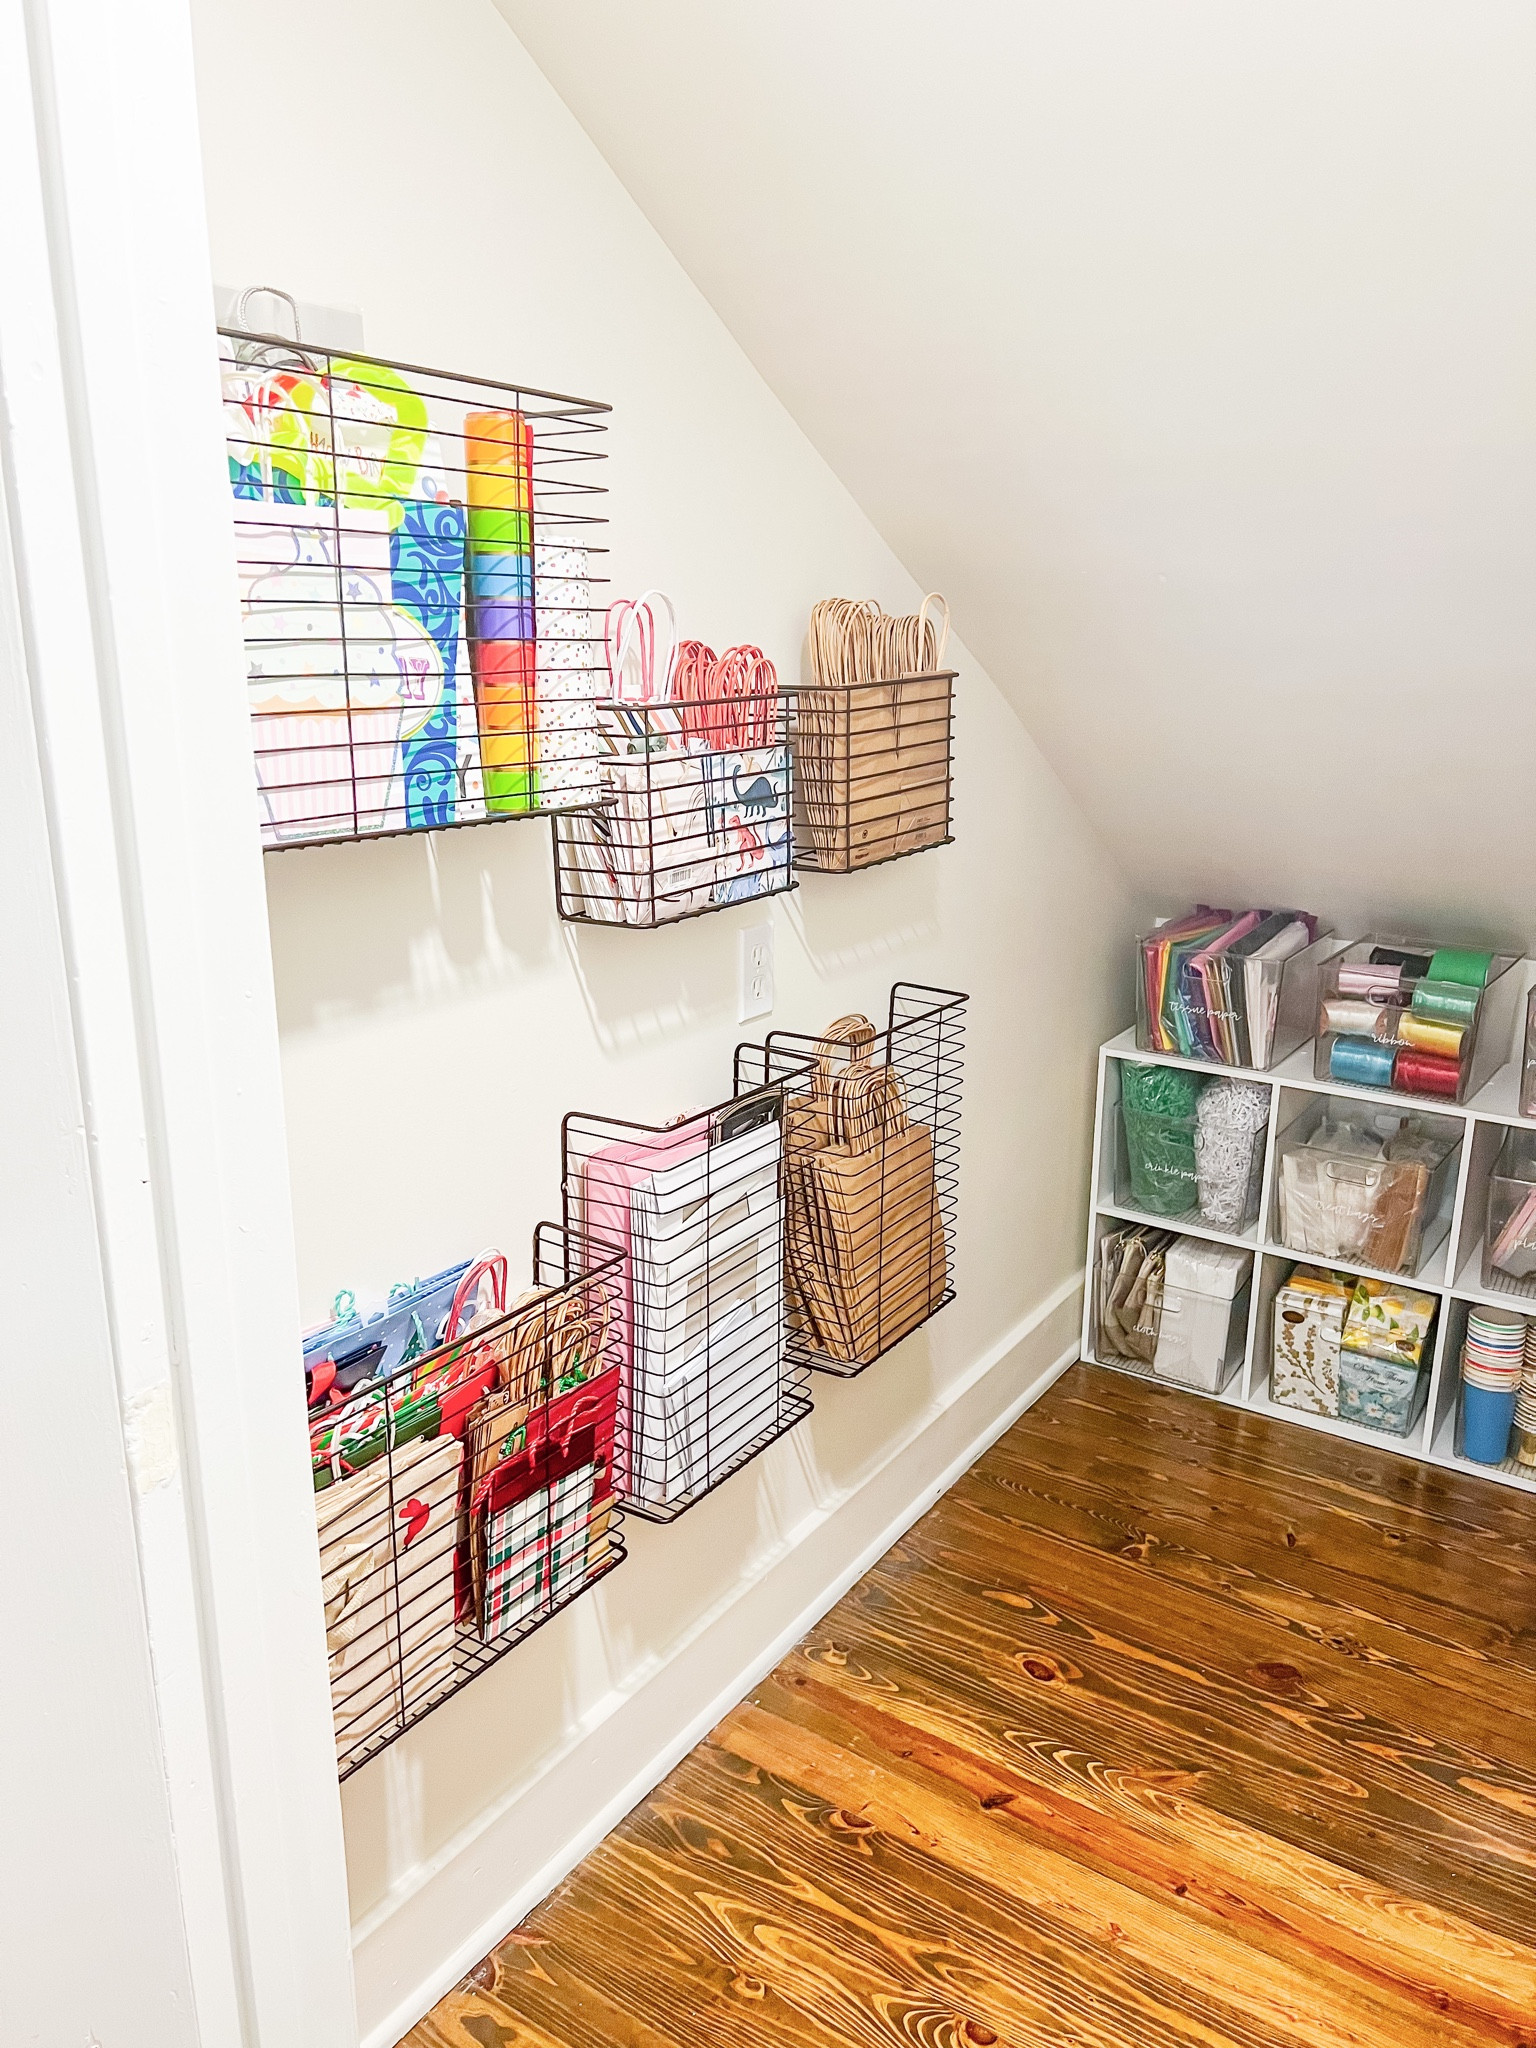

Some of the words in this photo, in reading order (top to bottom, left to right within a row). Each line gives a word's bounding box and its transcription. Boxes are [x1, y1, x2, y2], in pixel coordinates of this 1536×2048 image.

[1168, 1001, 1206, 1015] tissue
[1206, 1008, 1243, 1021] paper
[1371, 1033, 1416, 1047] ribbon
[1145, 1162, 1180, 1176] crinkle
[1132, 1324, 1158, 1338] cloth
